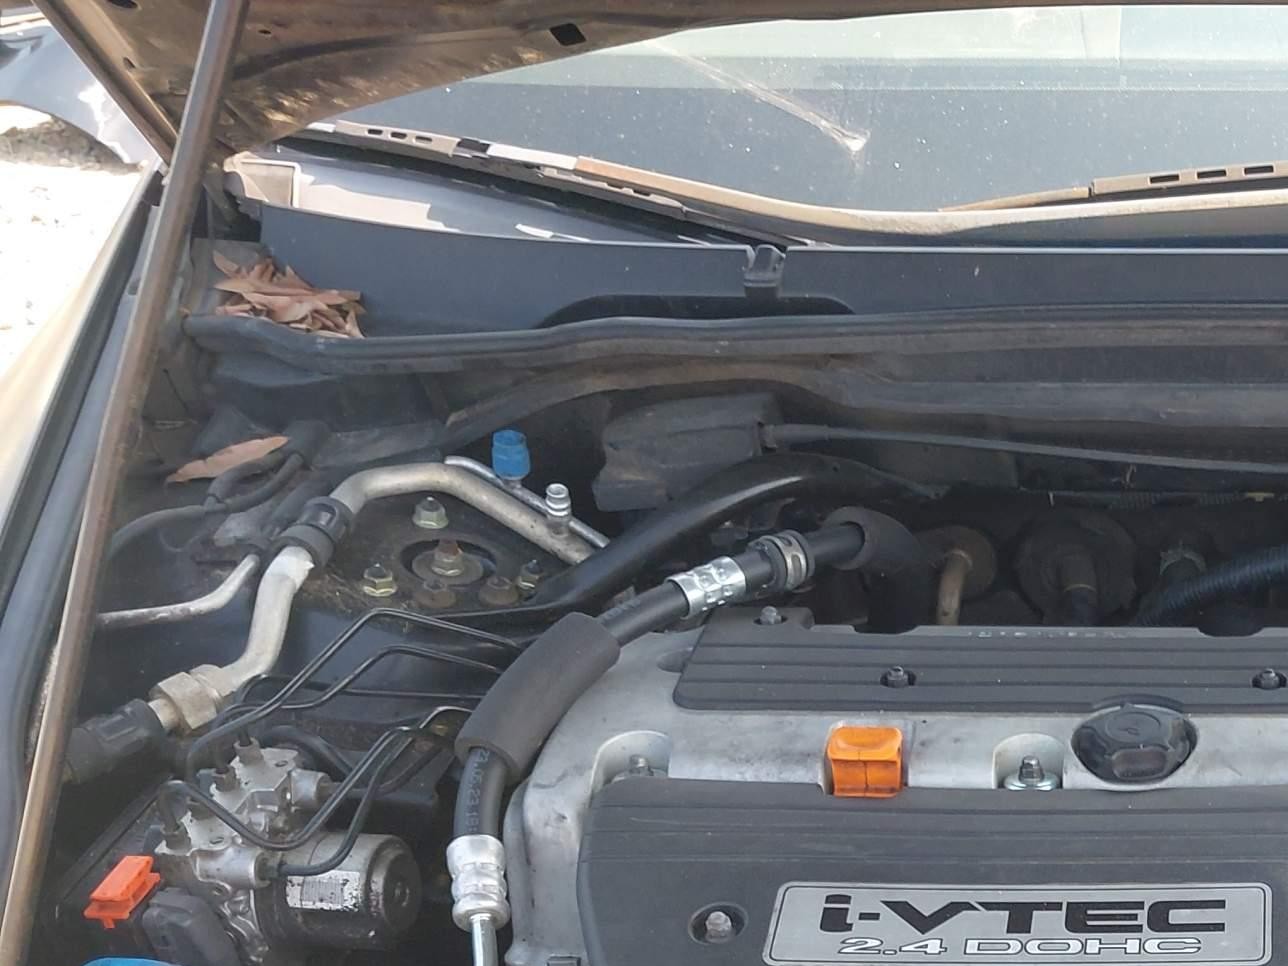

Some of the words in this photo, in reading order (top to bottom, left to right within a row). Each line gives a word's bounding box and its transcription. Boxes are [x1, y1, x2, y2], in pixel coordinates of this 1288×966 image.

[819, 893, 1227, 936] i-VTEC
[836, 937, 948, 956] 2.4
[962, 937, 1203, 956] DOHC
